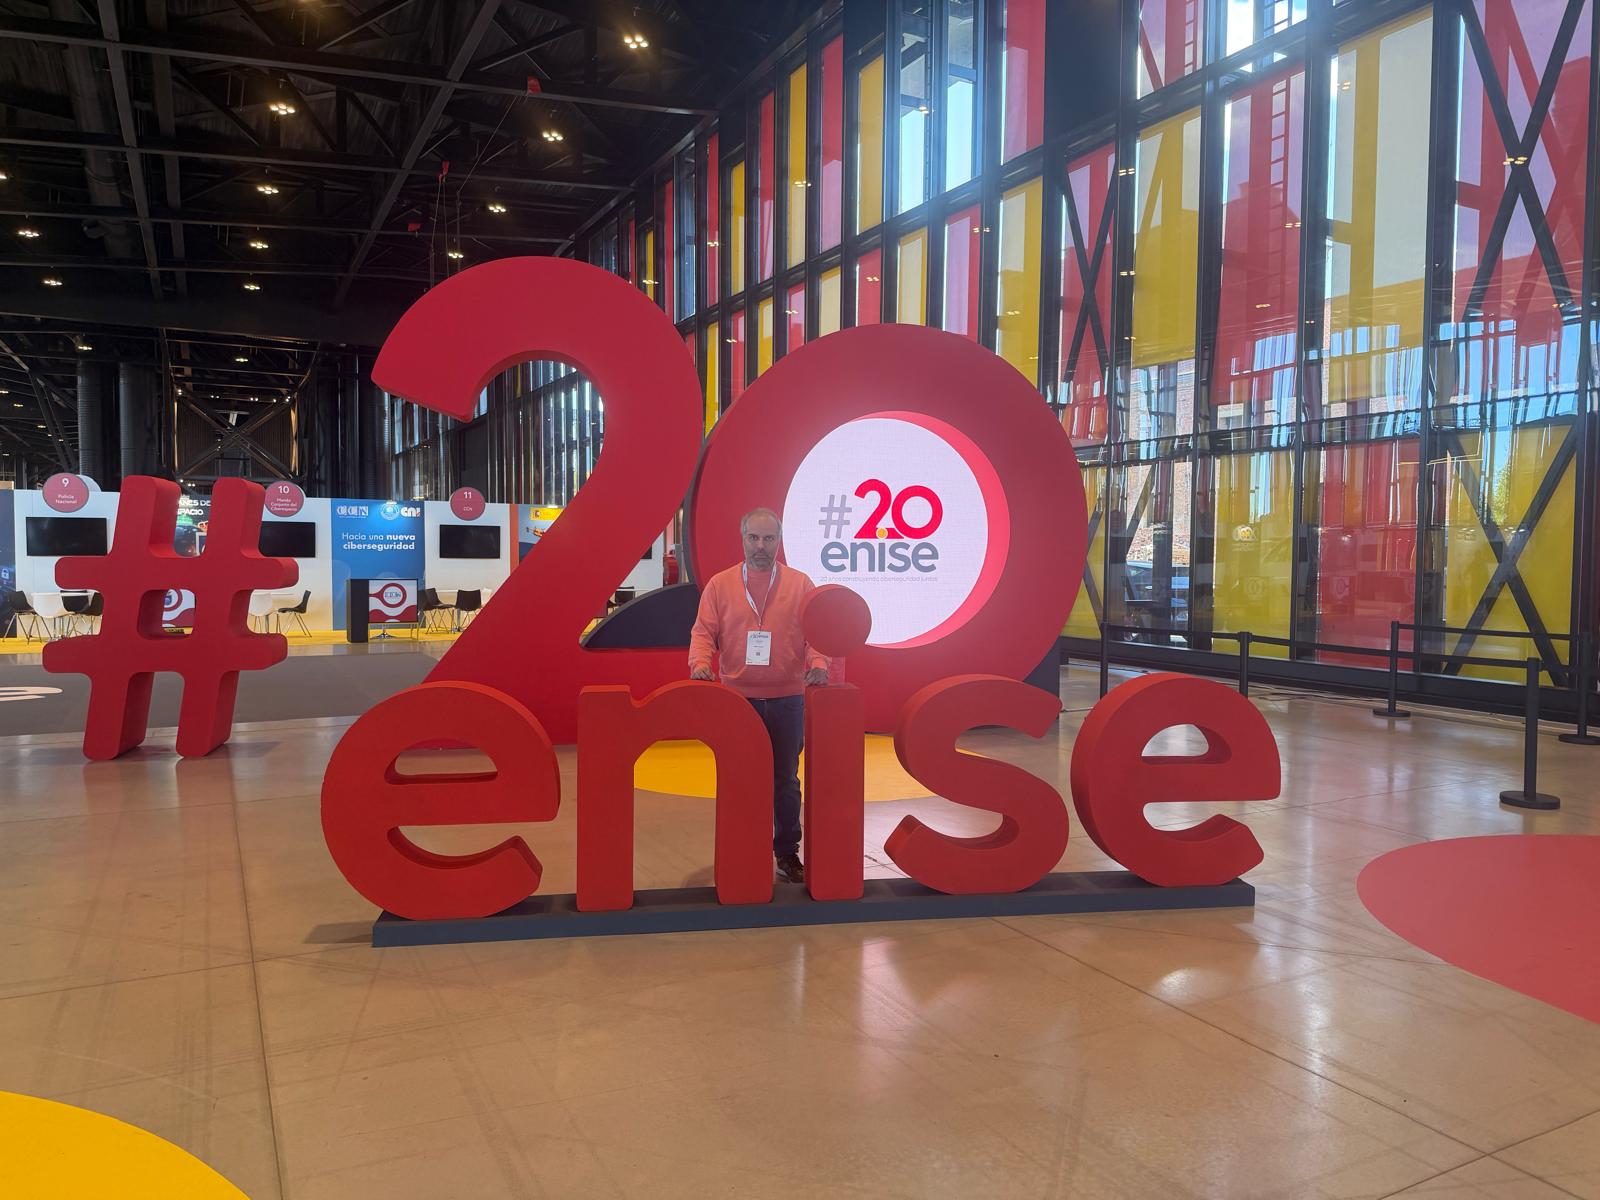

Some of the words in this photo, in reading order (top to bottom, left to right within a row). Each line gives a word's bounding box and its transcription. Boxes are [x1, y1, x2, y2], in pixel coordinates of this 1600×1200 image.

[62, 477, 69, 487] 9
[278, 485, 290, 494] 10
[463, 491, 472, 499] 11
[342, 532, 367, 541] Hacia
[343, 542, 415, 552] ciberseguridad
[821, 541, 939, 572] enise
[321, 583, 1281, 922] enise
